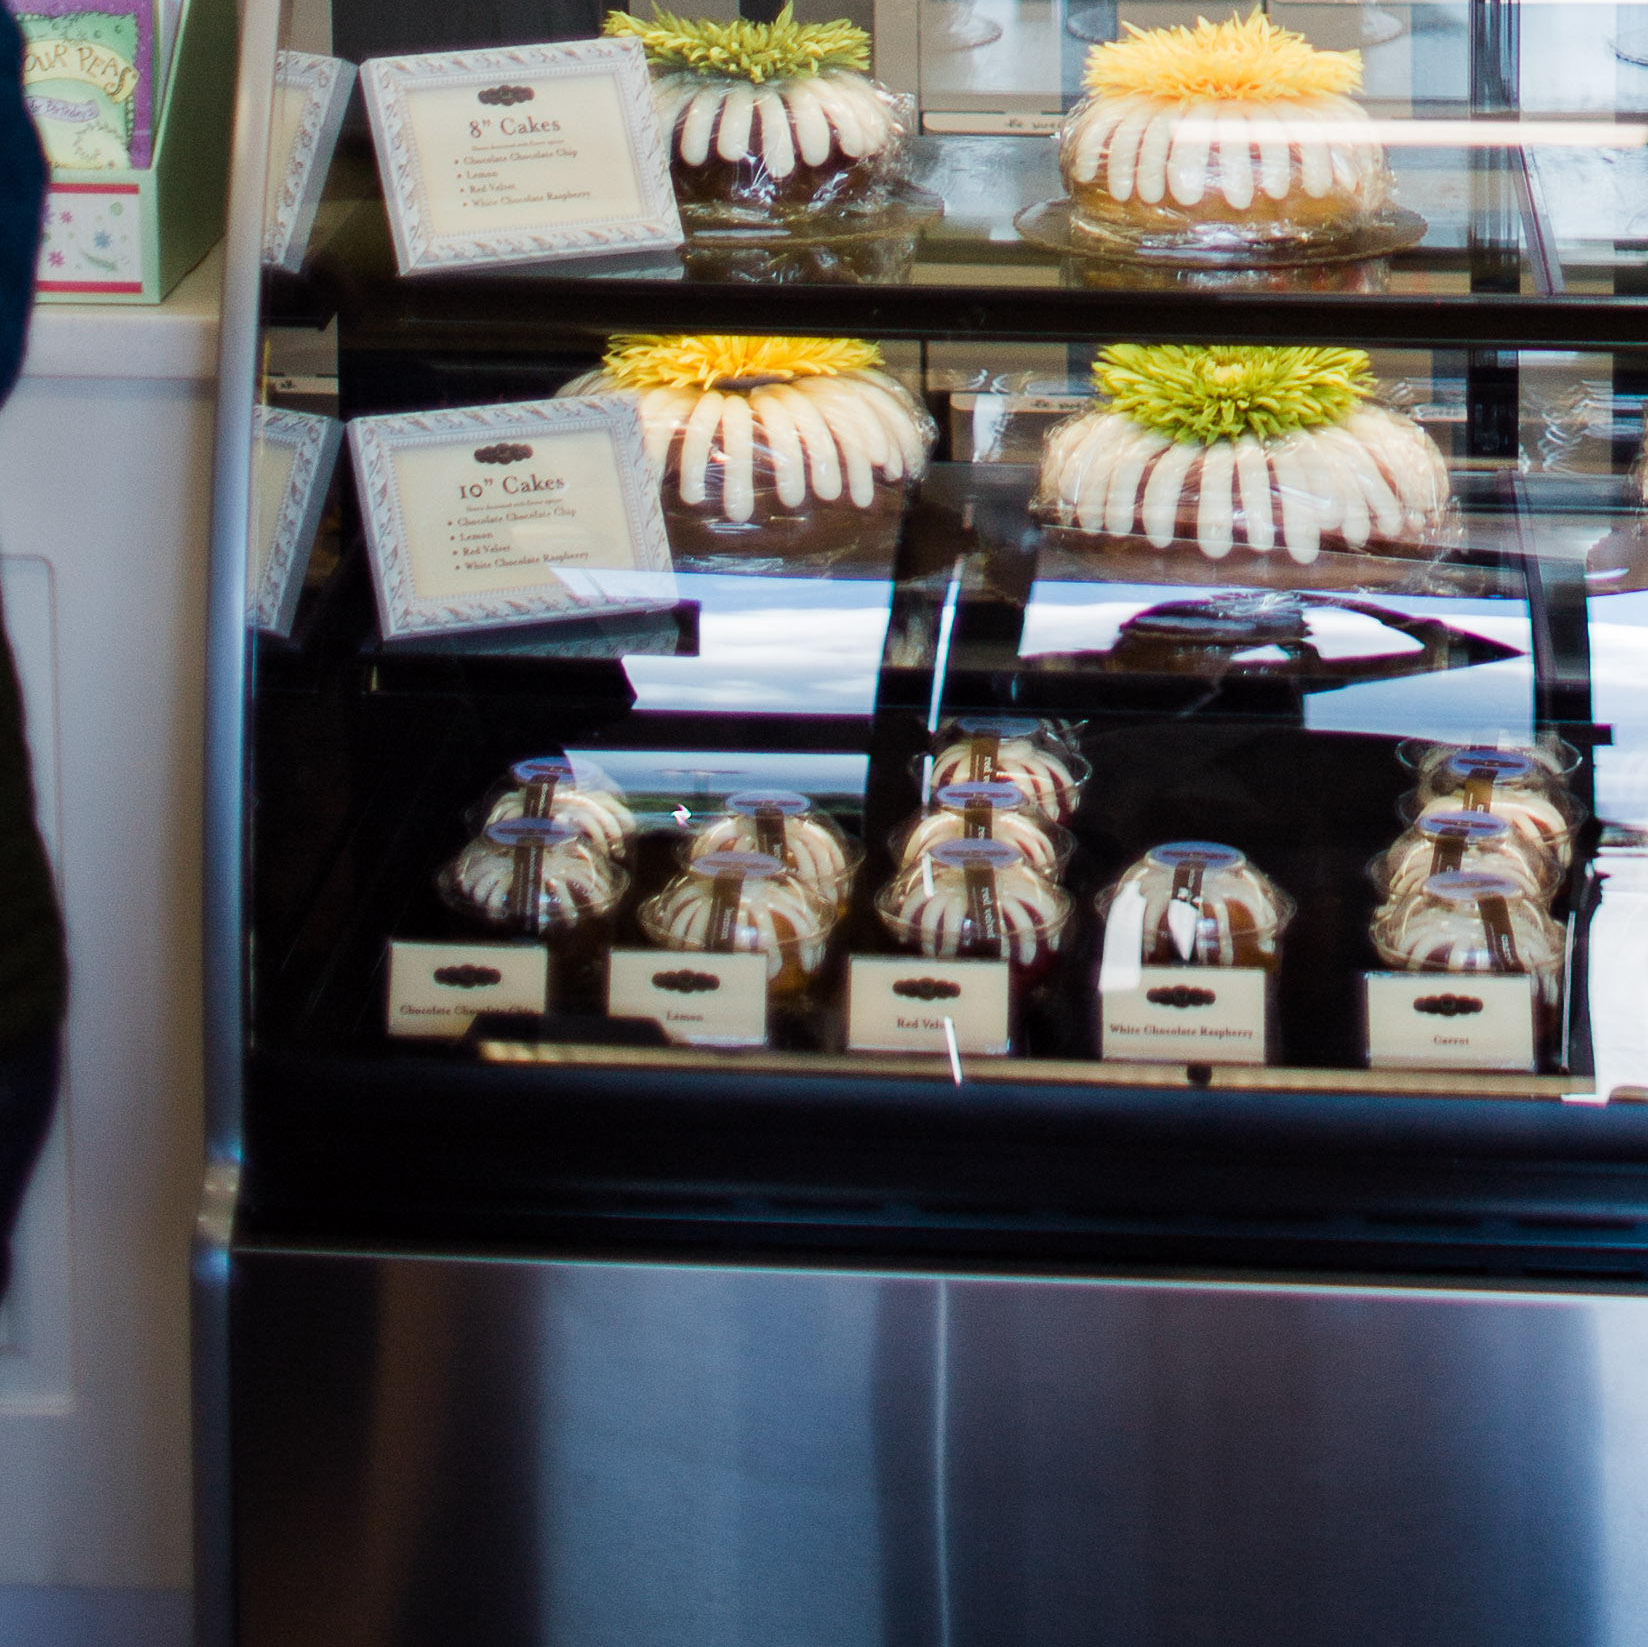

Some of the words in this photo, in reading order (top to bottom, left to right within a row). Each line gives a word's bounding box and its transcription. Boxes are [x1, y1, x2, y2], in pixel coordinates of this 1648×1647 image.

[77, 47, 132, 96] PEAS
[500, 116, 561, 136] Cakes
[503, 474, 565, 495] Cakes
[1110, 1023, 1140, 1036] White
[1144, 1024, 1198, 1037] Chocolate
[1200, 1025, 1254, 1040] Raspberry
[1433, 1035, 1470, 1046] Carrot
